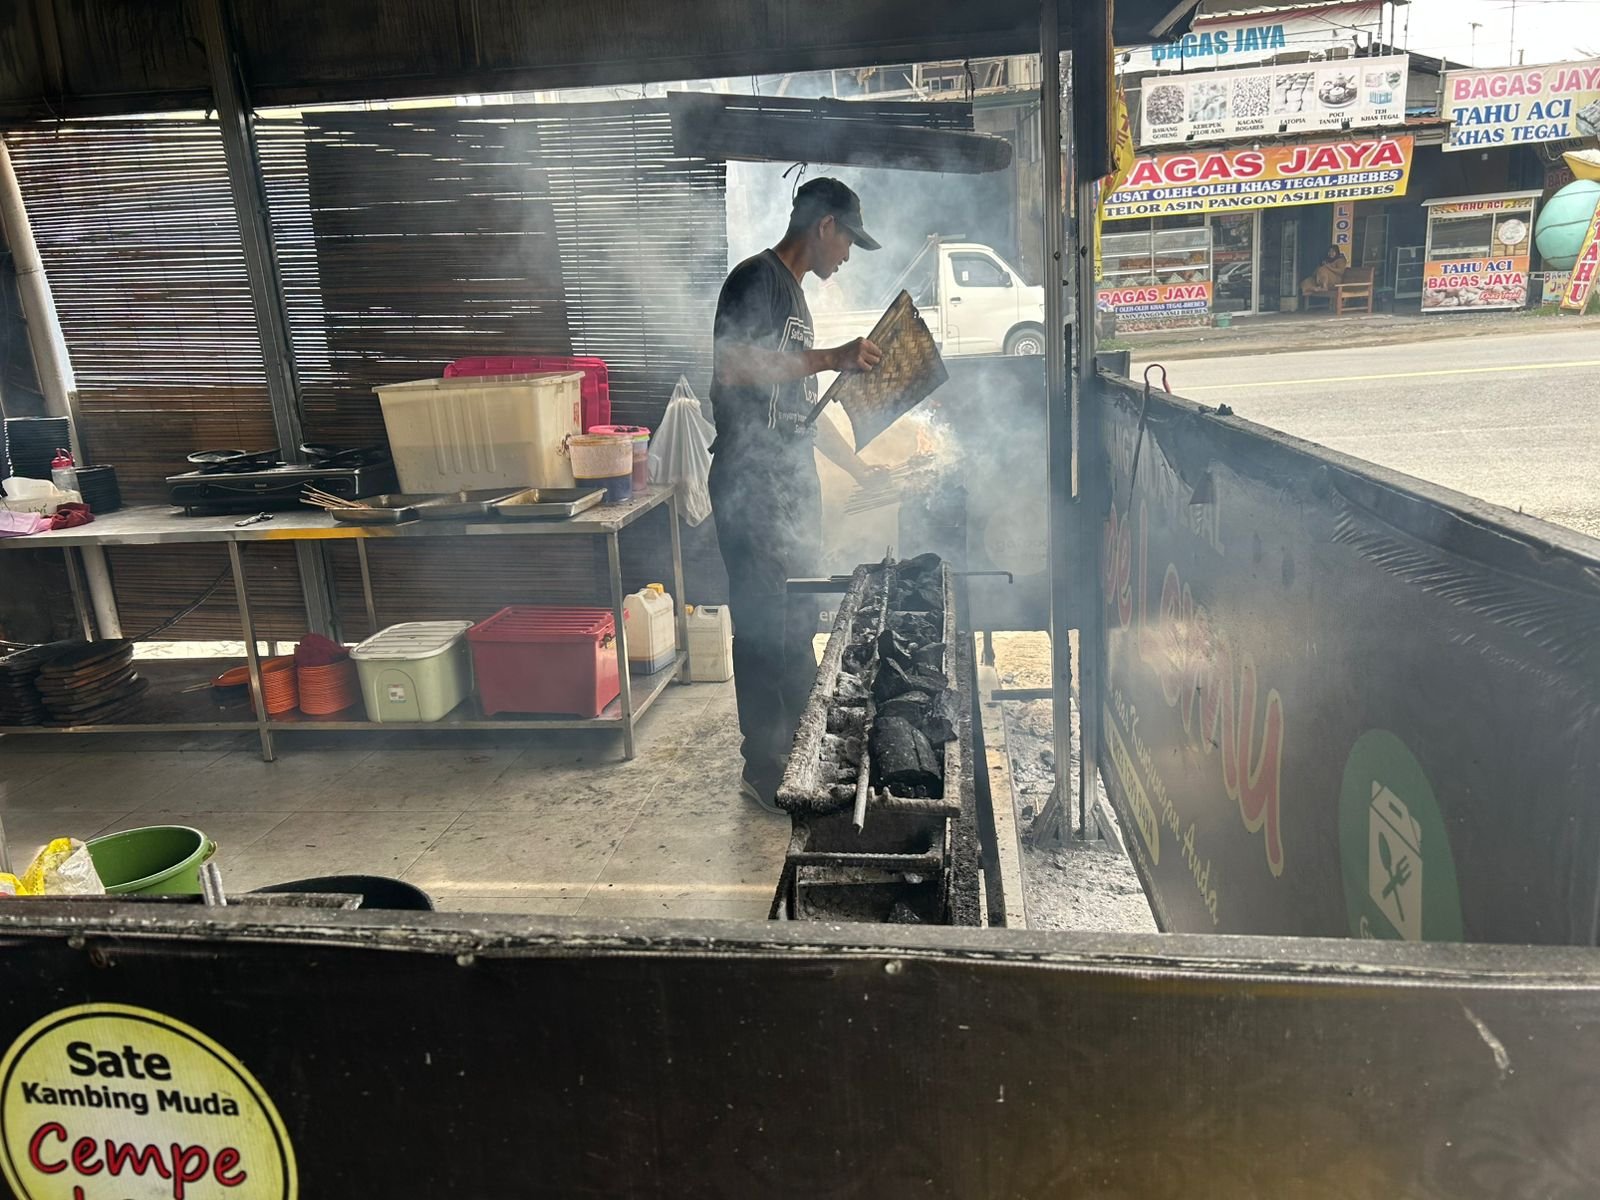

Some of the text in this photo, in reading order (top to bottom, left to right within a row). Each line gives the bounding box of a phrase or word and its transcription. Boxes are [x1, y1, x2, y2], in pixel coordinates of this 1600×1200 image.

[1152, 24, 1285, 60] BAGAS JAYA
[1454, 67, 1600, 100] BAGAS JAY
[1452, 99, 1572, 127] TAHU ACI
[1451, 123, 1571, 146] KHAS TEGAL
[1120, 142, 1404, 188] AGAS JAYA
[1153, 183, 1237, 200] OLEH-OLEH
[1240, 180, 1282, 193] KHAS
[1284, 170, 1399, 189] TEGAL-BREBES
[1105, 185, 1394, 217] TELOR ASIN PANGON ASLI BREBES
[1457, 203, 1484, 211] TAHU
[1428, 273, 1522, 288] BAGAS JAYA
[1441, 260, 1512, 274] TAHU ACI
[1100, 286, 1206, 306] BAGAS JAYA
[66, 1041, 173, 1081] Sate
[21, 1081, 240, 1116] Kambing Muda
[28, 1121, 247, 1200] Cempe
